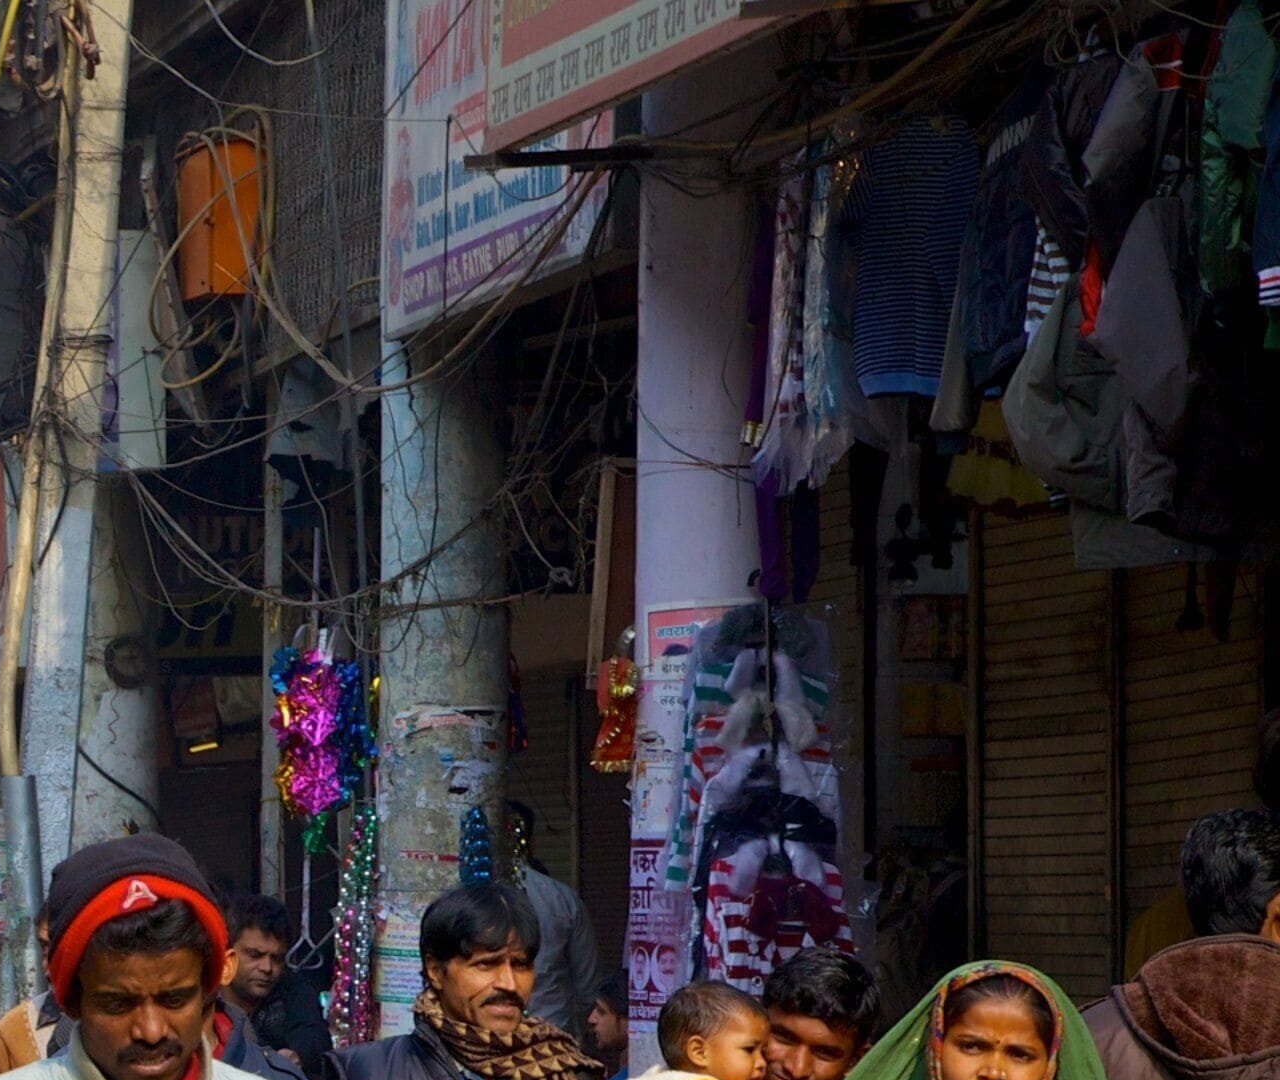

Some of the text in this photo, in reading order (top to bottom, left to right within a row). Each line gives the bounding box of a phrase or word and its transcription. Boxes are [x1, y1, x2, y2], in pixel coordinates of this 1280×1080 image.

[492, 83, 509, 124] राम
[514, 72, 532, 113] राम
[536, 61, 555, 101] राम
[560, 48, 580, 89] राम
[585, 35, 606, 79] राम
[610, 23, 632, 66] राम
[637, 8, 660, 52] राम
[664, 0, 686, 40] राम
